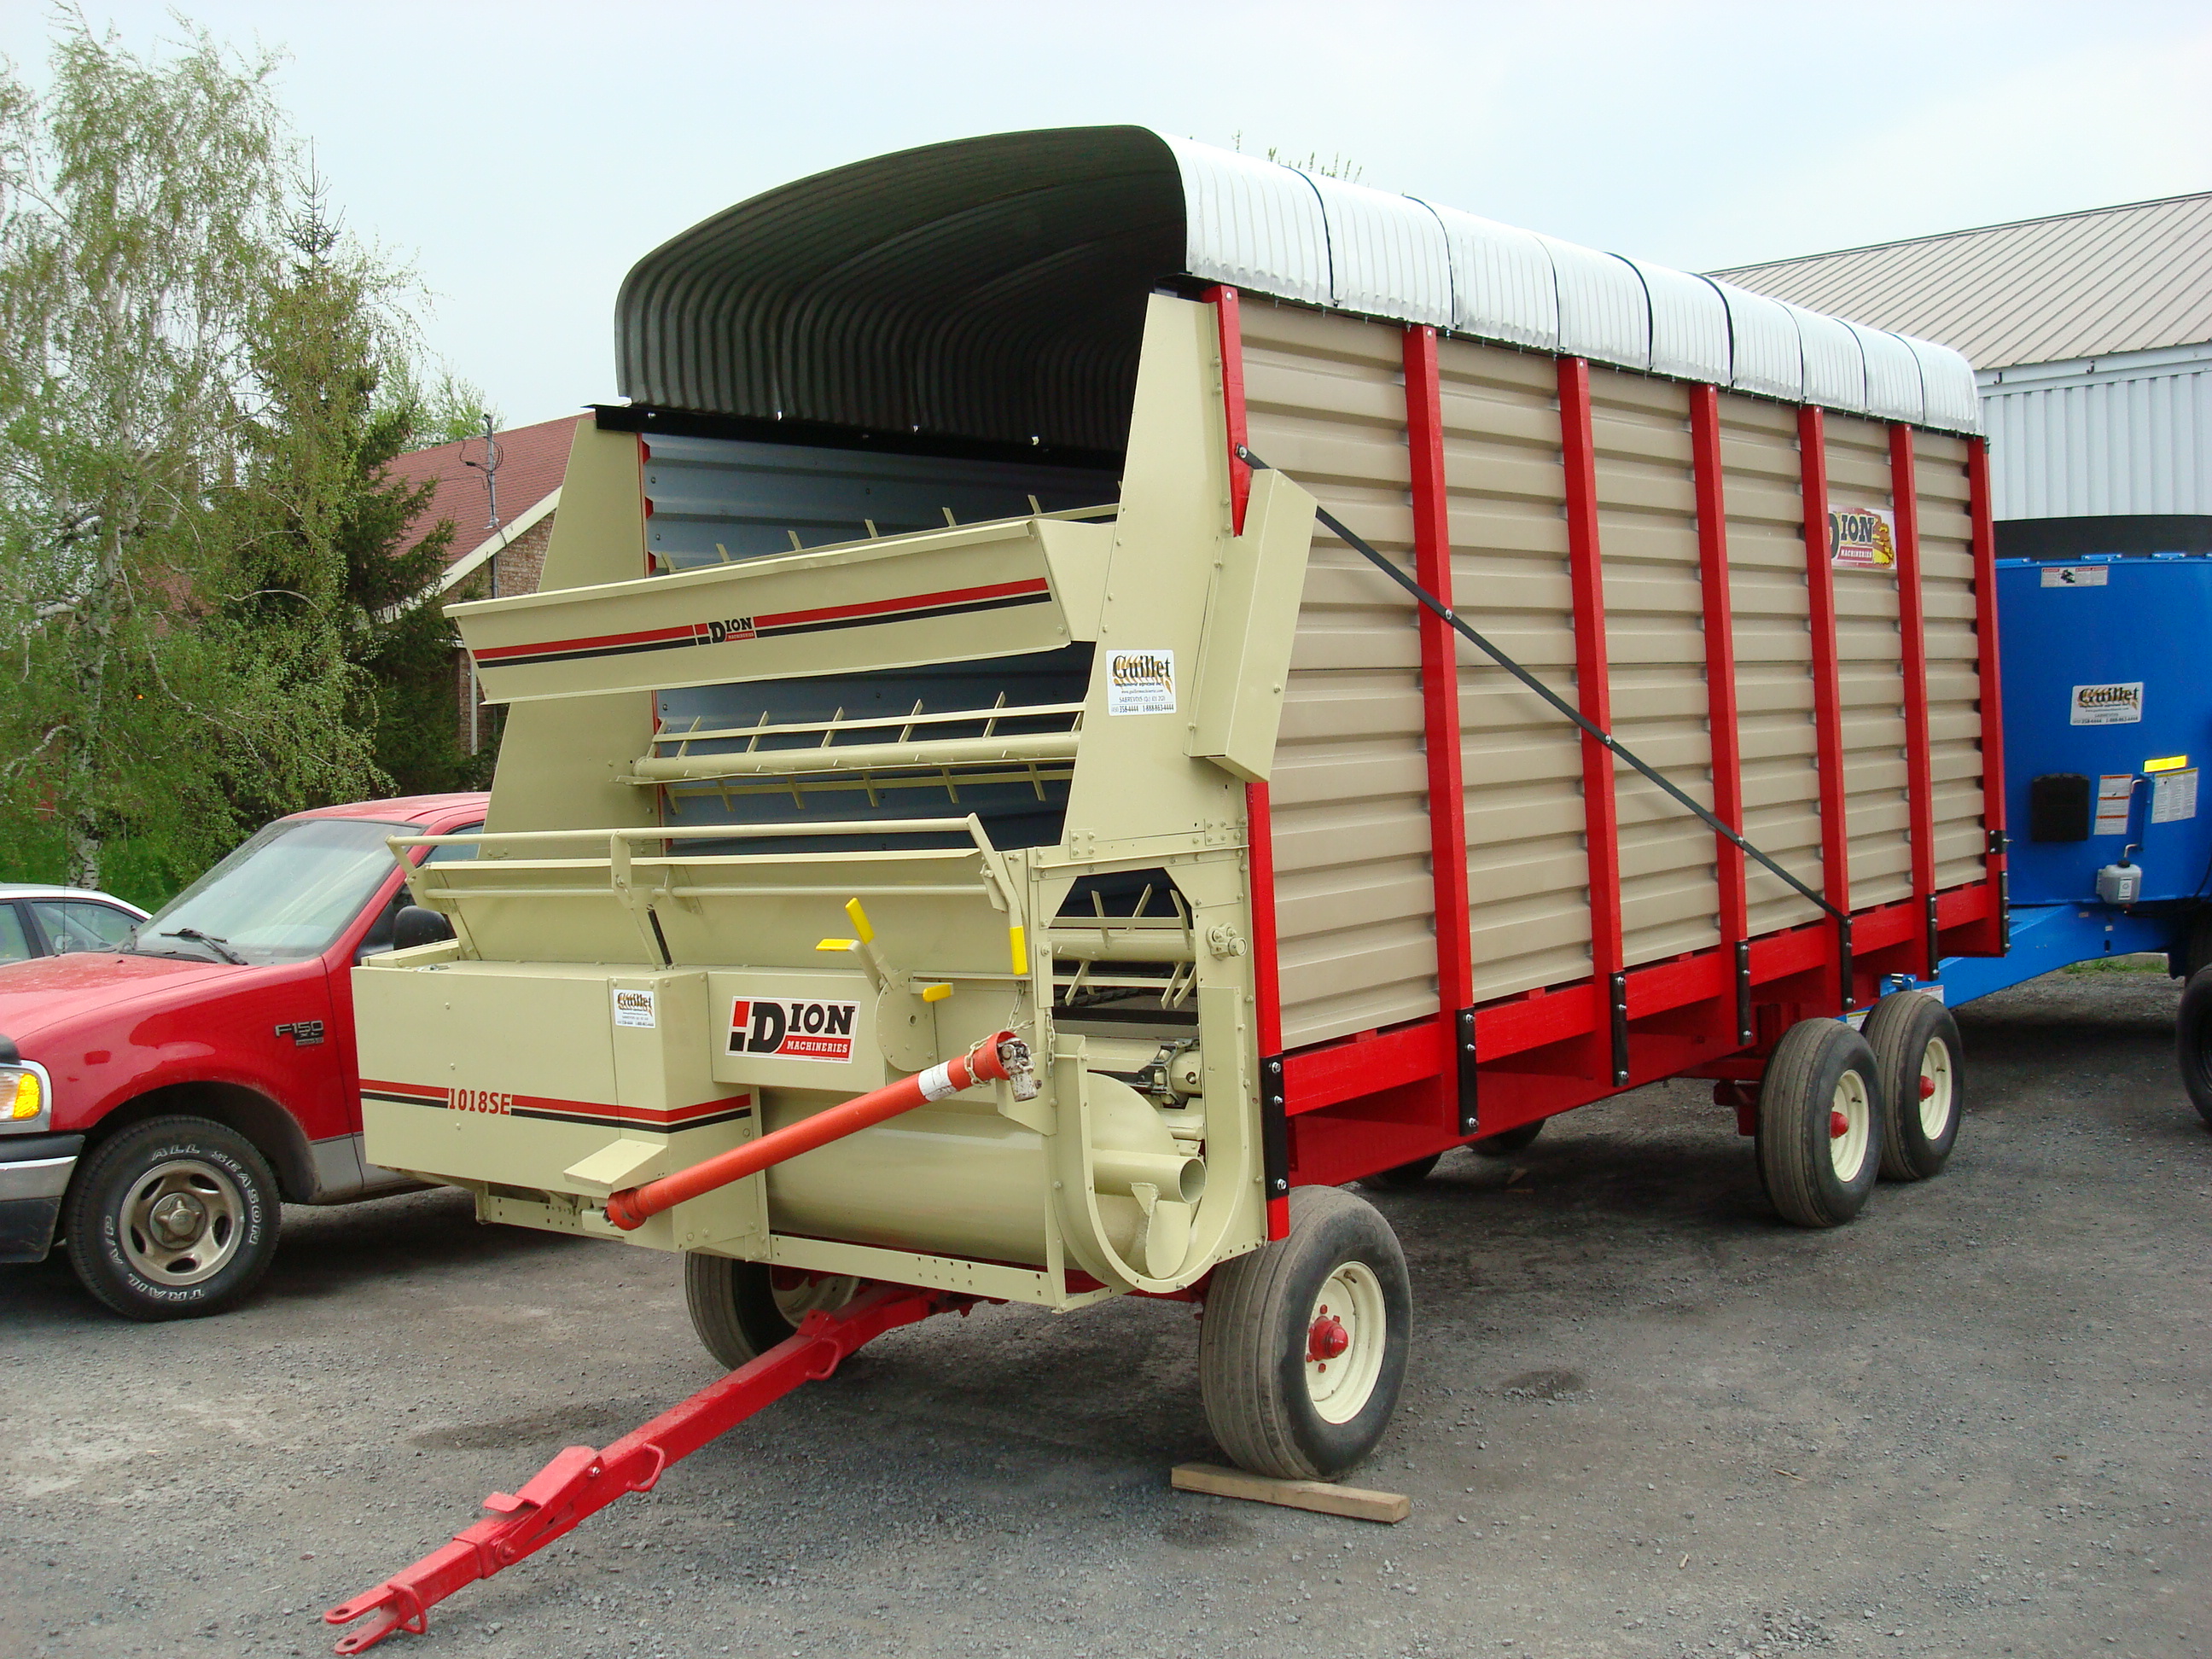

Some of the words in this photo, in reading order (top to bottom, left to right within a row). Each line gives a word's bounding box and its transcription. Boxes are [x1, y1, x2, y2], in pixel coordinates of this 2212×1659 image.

[708, 617, 753, 643] DION
[1113, 655, 1170, 678] Guillet
[2078, 687, 2139, 703] Guillet
[748, 1002, 855, 1053] DION
[787, 1040, 848, 1053] MACHINERIES
[450, 1088, 511, 1115] 1018SE
[151, 1144, 200, 1161] ALL
[212, 1150, 262, 1245] SEASON
[128, 1272, 205, 1301] TRAIL
